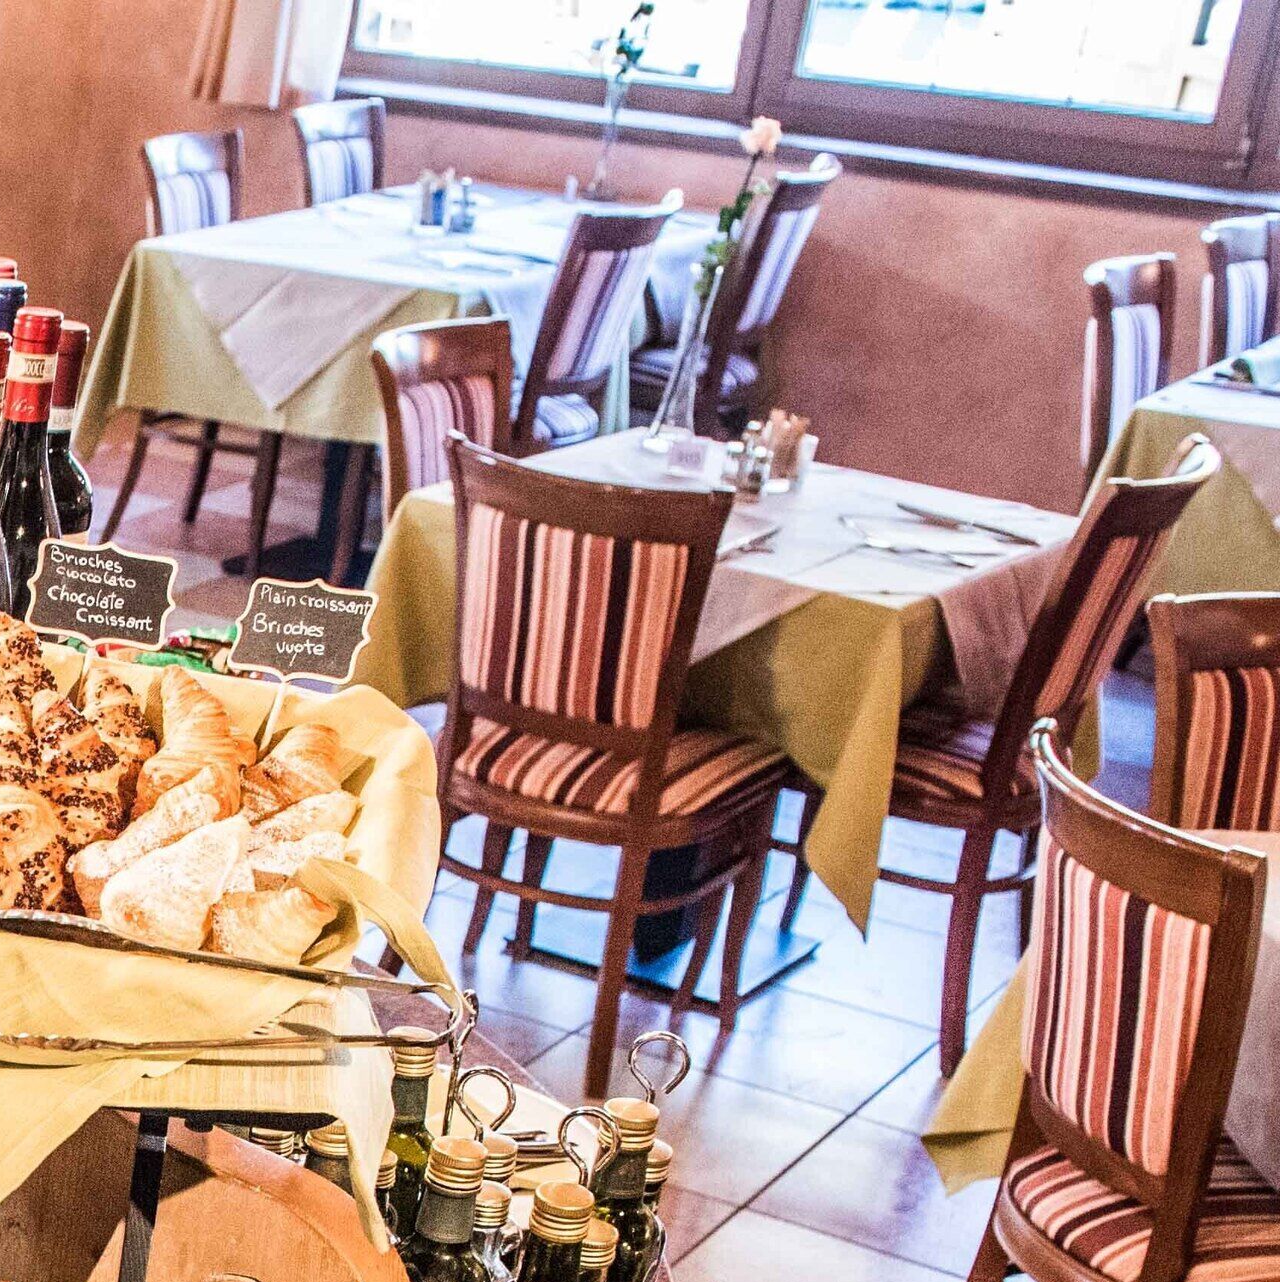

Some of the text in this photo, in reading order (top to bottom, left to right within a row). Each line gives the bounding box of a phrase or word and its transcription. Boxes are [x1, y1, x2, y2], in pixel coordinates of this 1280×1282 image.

[50, 545, 123, 574] Brioches
[260, 584, 371, 616] Plain croissant
[252, 612, 325, 638] Brioches
[276, 638, 325, 660] vuote
